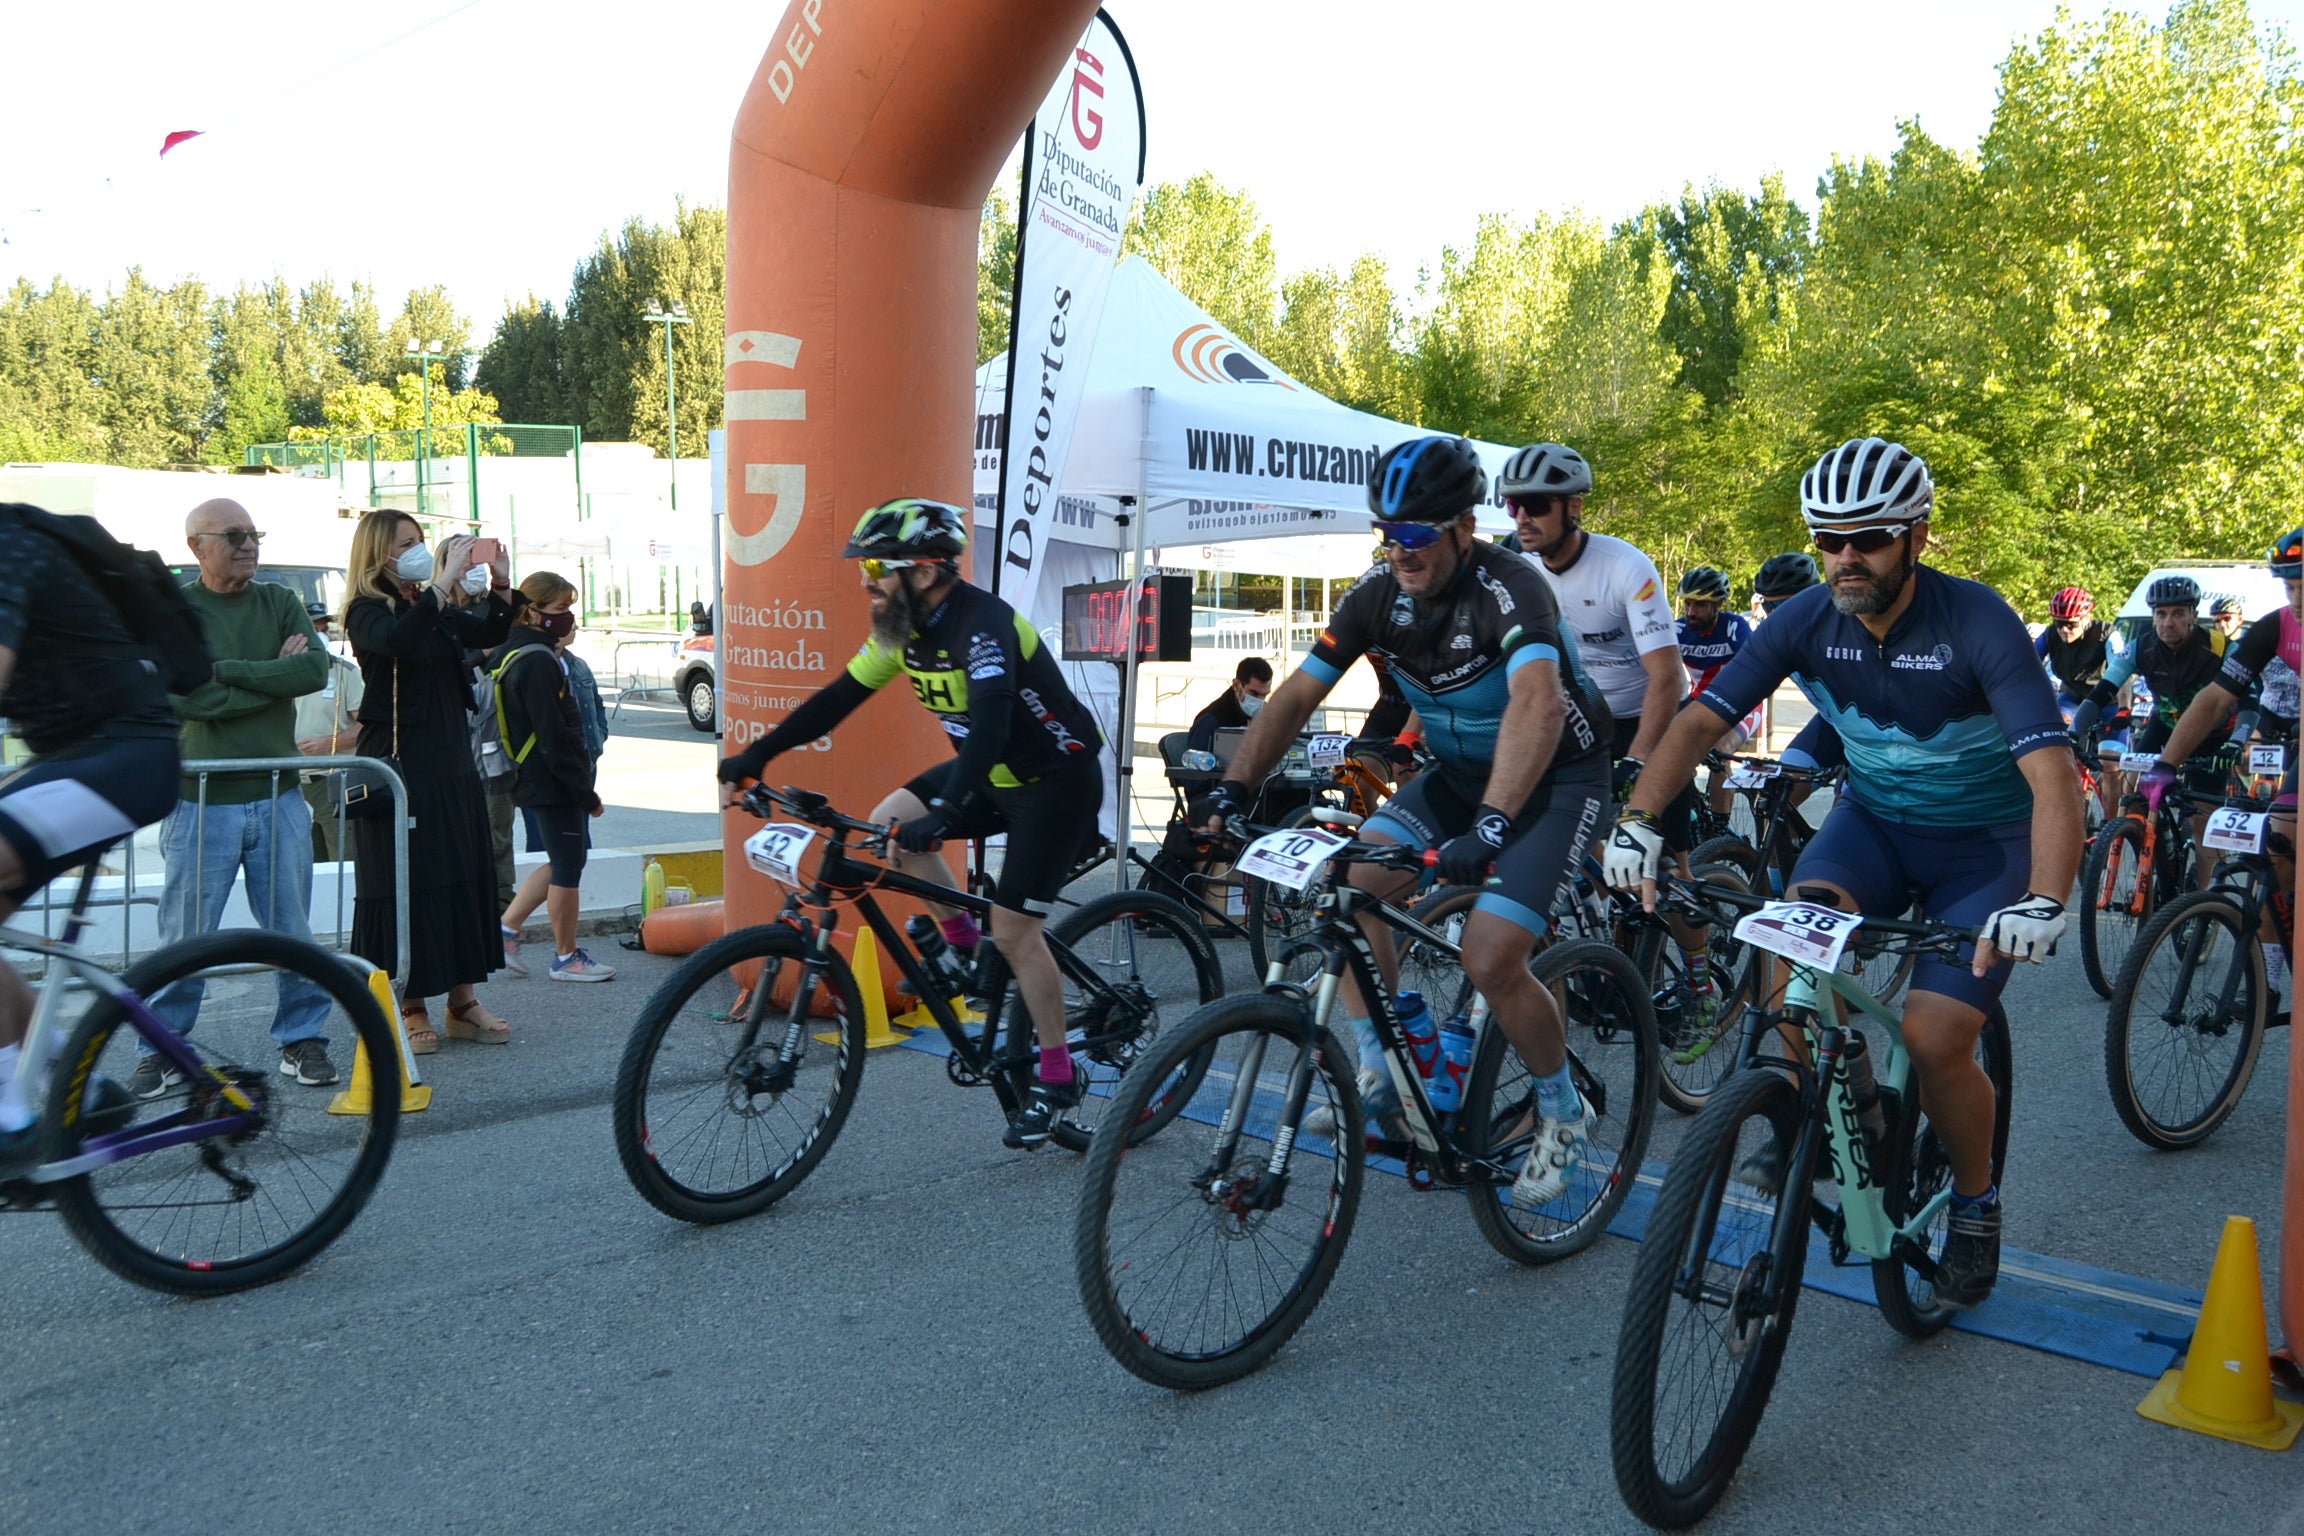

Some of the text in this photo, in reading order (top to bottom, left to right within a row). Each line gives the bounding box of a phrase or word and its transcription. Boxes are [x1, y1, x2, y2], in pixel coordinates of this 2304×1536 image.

[1042, 130, 1122, 203] Diputación
[1039, 169, 1119, 234] de Granada
[1038, 207, 1086, 244] Avanzamos
[1004, 285, 1072, 580] Deportes
[723, 632, 827, 671] Granada
[1826, 646, 1863, 661] GOBIK
[1895, 654, 1939, 663] ALMA
[1890, 660, 1944, 671] BIKERS
[1317, 739, 1342, 752] 132
[2260, 752, 2274, 763] 12
[2224, 812, 2252, 831] 52
[763, 832, 791, 861] 42
[1280, 836, 1314, 857] 10
[1267, 1124, 1295, 1175] ROCKSHOX
